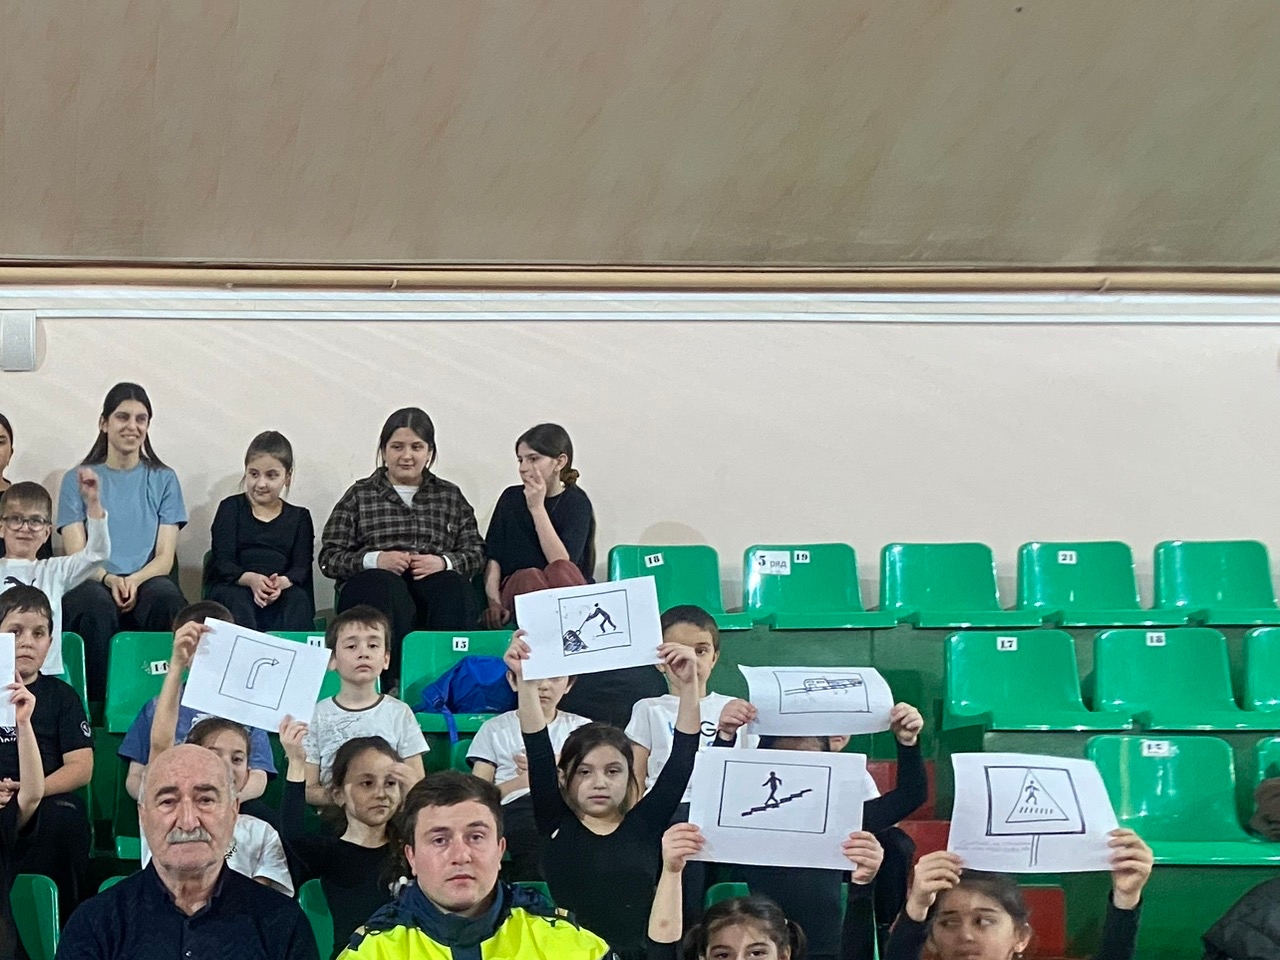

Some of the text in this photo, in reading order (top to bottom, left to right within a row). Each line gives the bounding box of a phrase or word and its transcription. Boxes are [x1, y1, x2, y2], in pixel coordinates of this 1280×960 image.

[648, 555, 660, 564] 18
[796, 553, 808, 561] 19
[758, 555, 787, 569] 5 ряд
[455, 641, 467, 649] 15
[1000, 640, 1013, 649] 17
